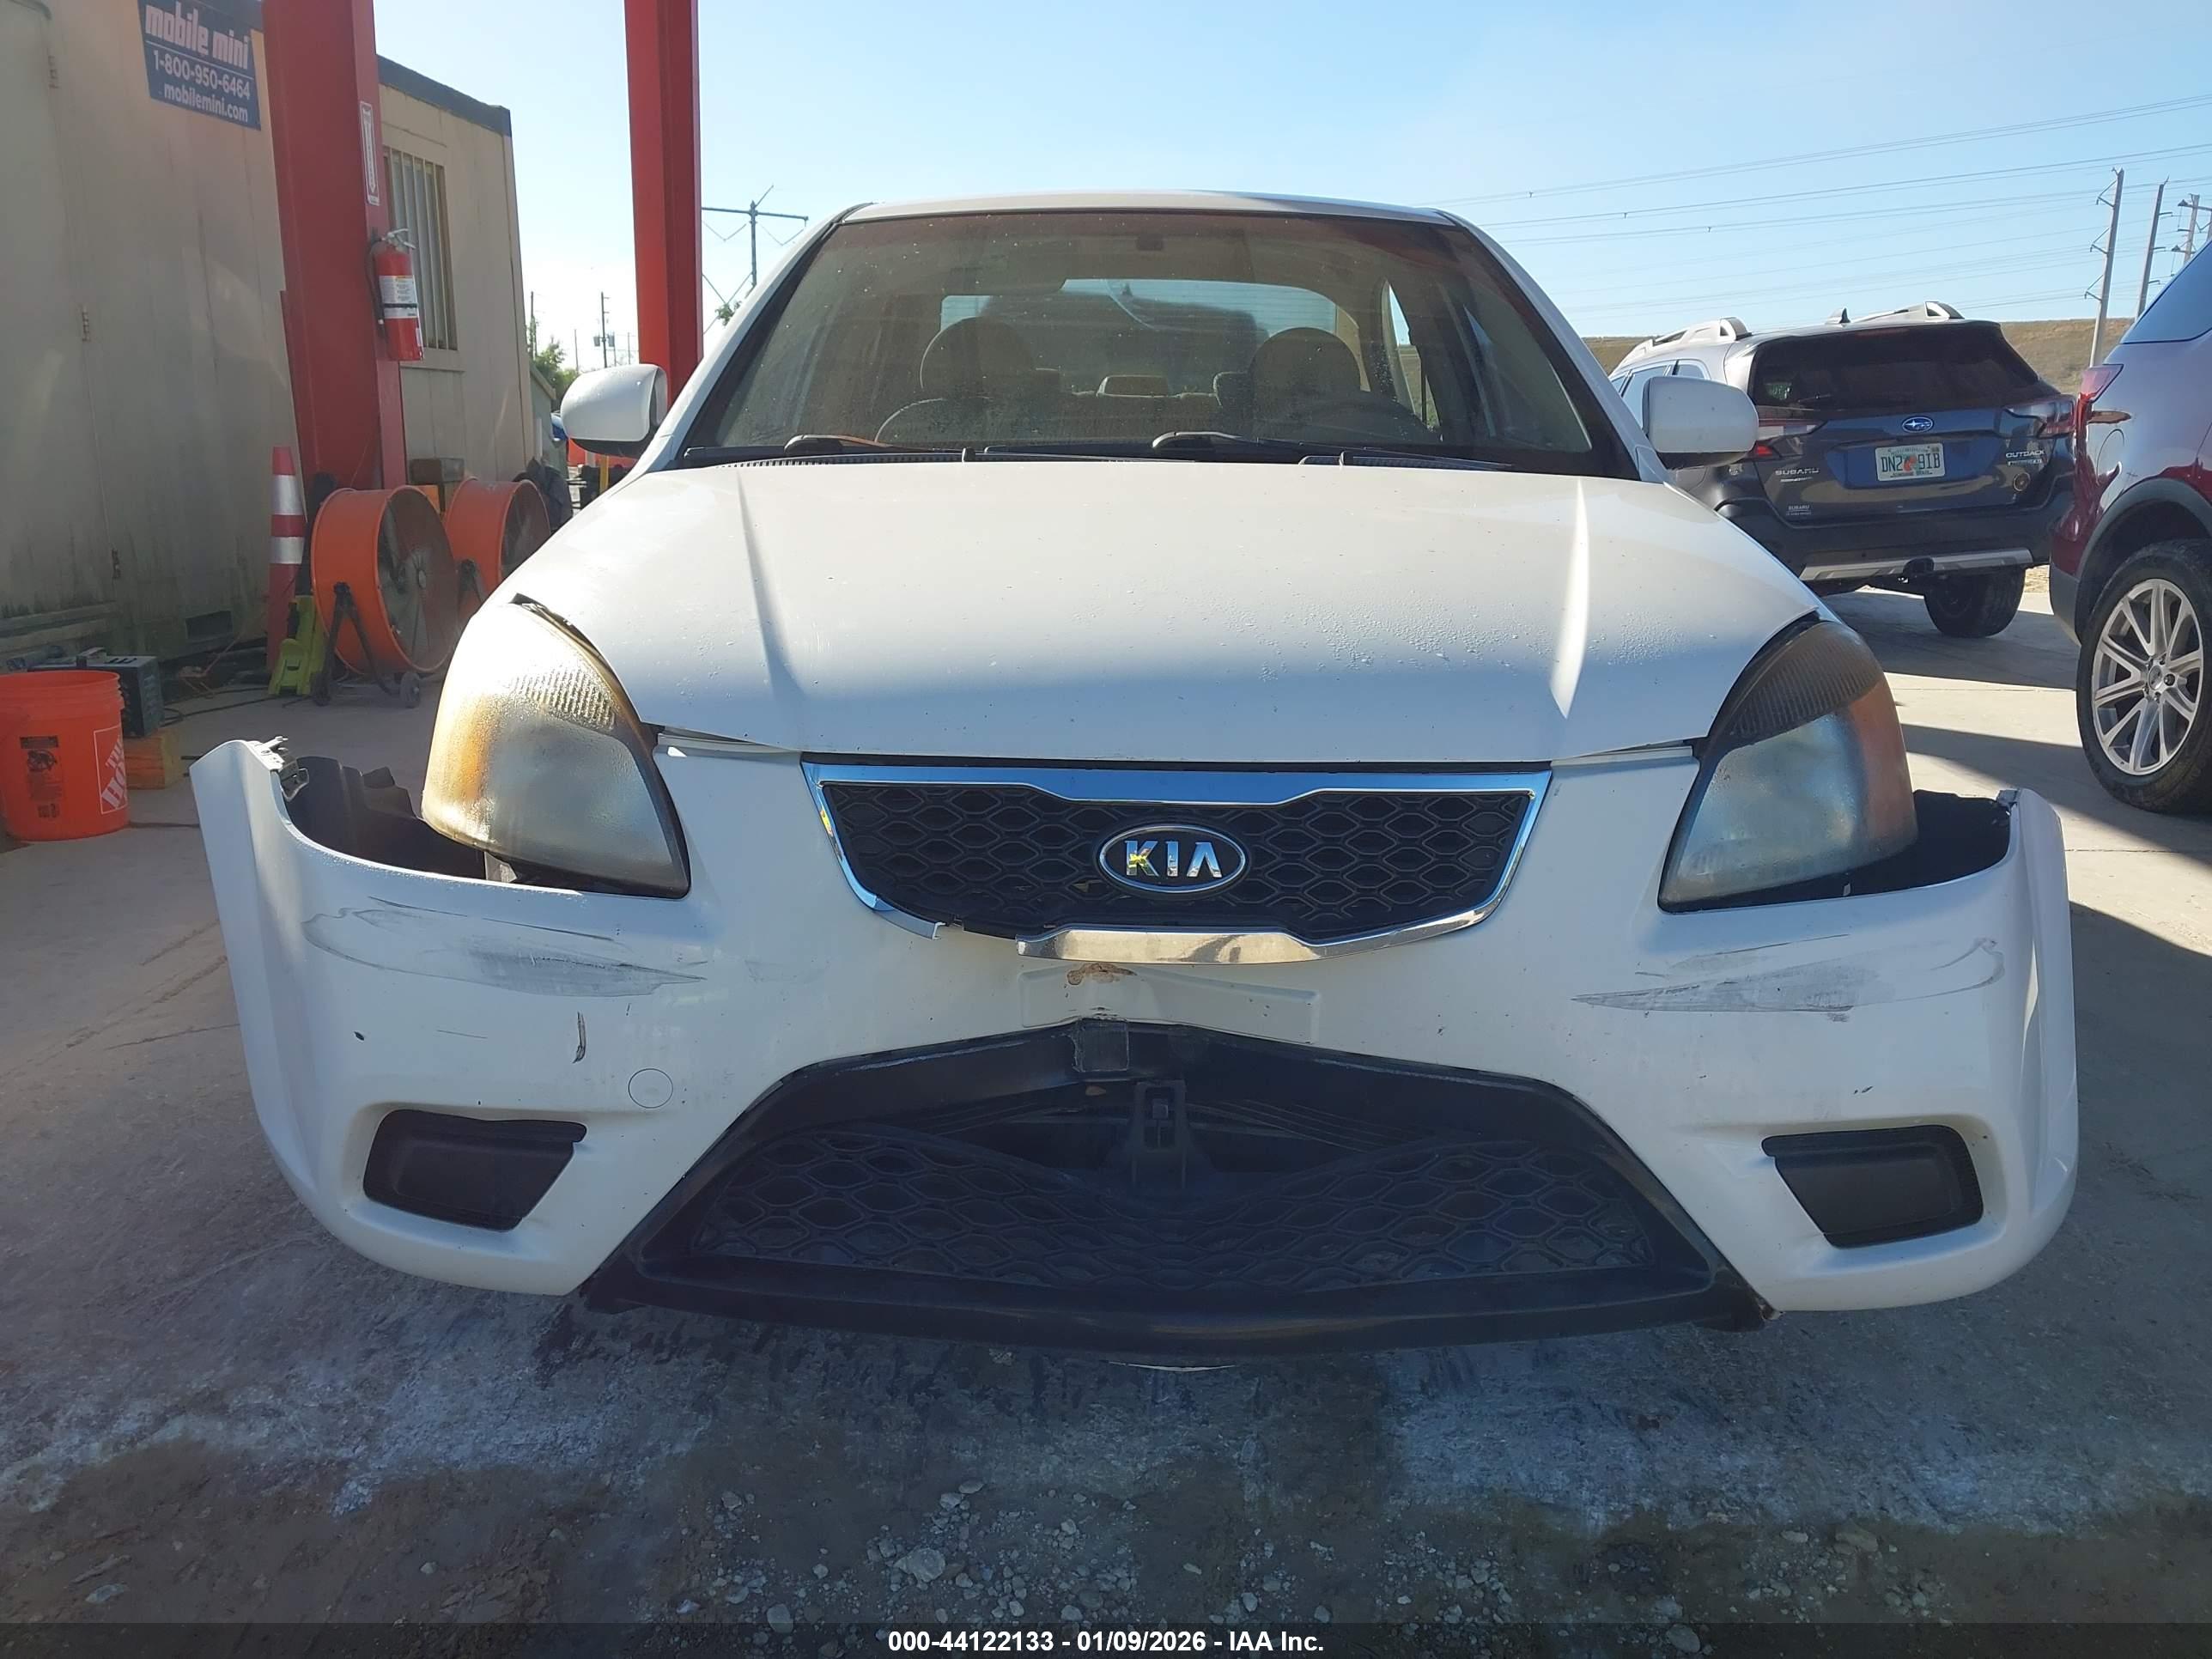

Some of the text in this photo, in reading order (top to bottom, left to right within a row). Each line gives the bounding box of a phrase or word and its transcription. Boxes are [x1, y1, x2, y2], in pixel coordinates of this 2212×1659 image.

[145, 1, 250, 70] mobile mini
[154, 50, 250, 100] 1-800-950-6464
[164, 83, 248, 123] mobilemini.com
[1124, 840, 1223, 878] KIA
